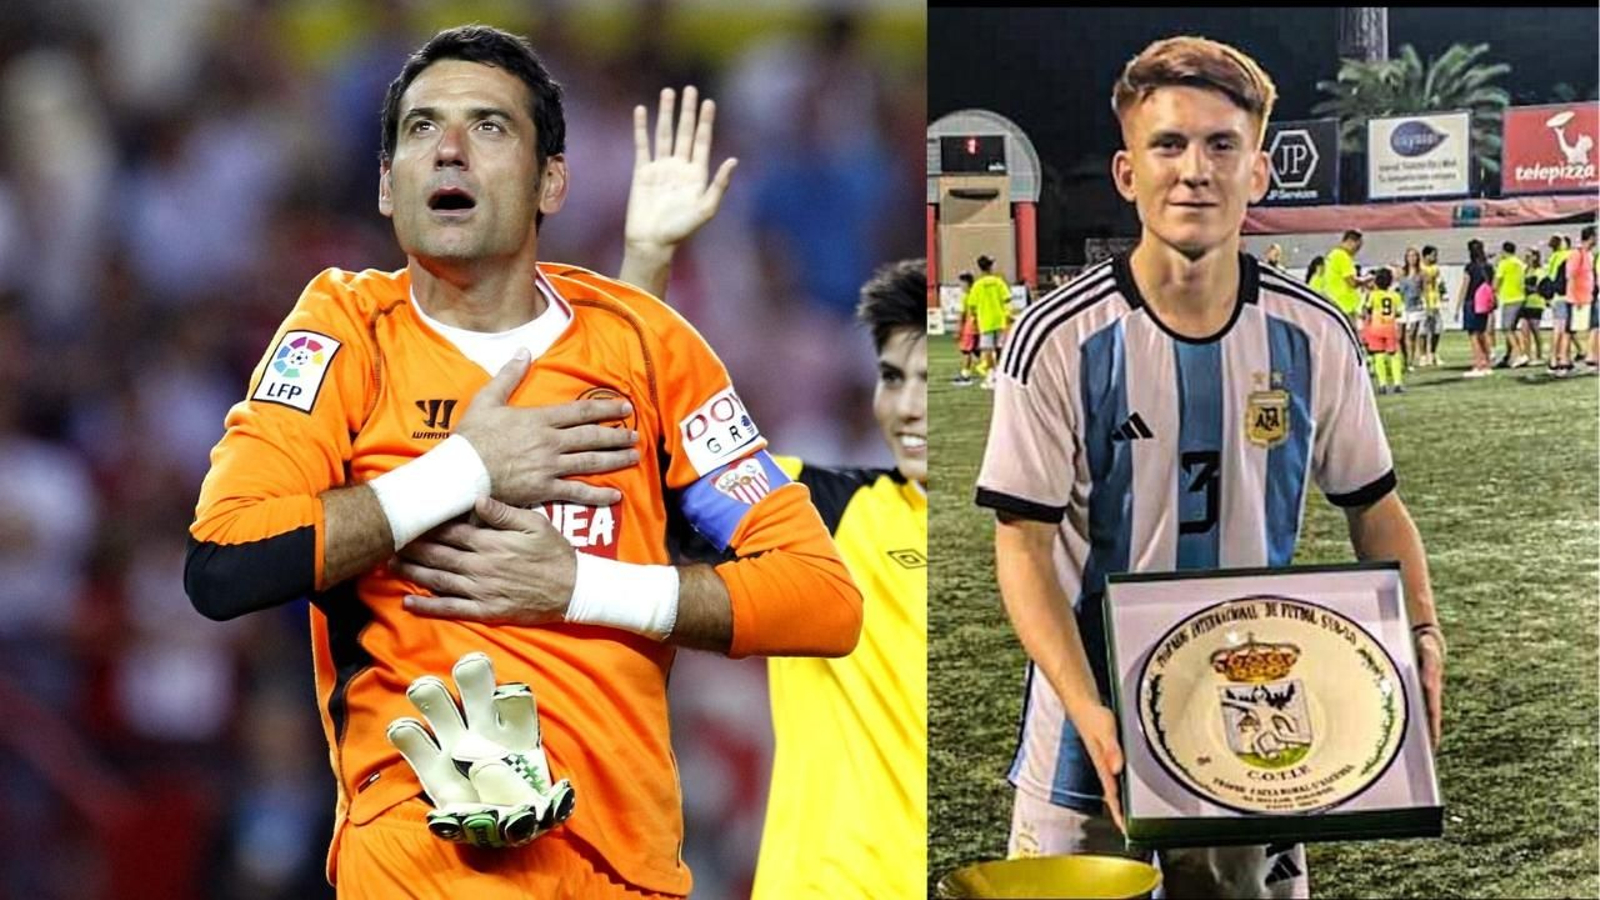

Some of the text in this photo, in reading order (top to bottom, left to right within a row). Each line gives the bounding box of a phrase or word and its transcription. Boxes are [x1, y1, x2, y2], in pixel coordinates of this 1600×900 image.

[1279, 145, 1307, 175] JP
[1515, 161, 1595, 186] telepizza
[1381, 297, 1392, 316] 9
[266, 382, 302, 400] LFP
[1180, 451, 1220, 534] 3
